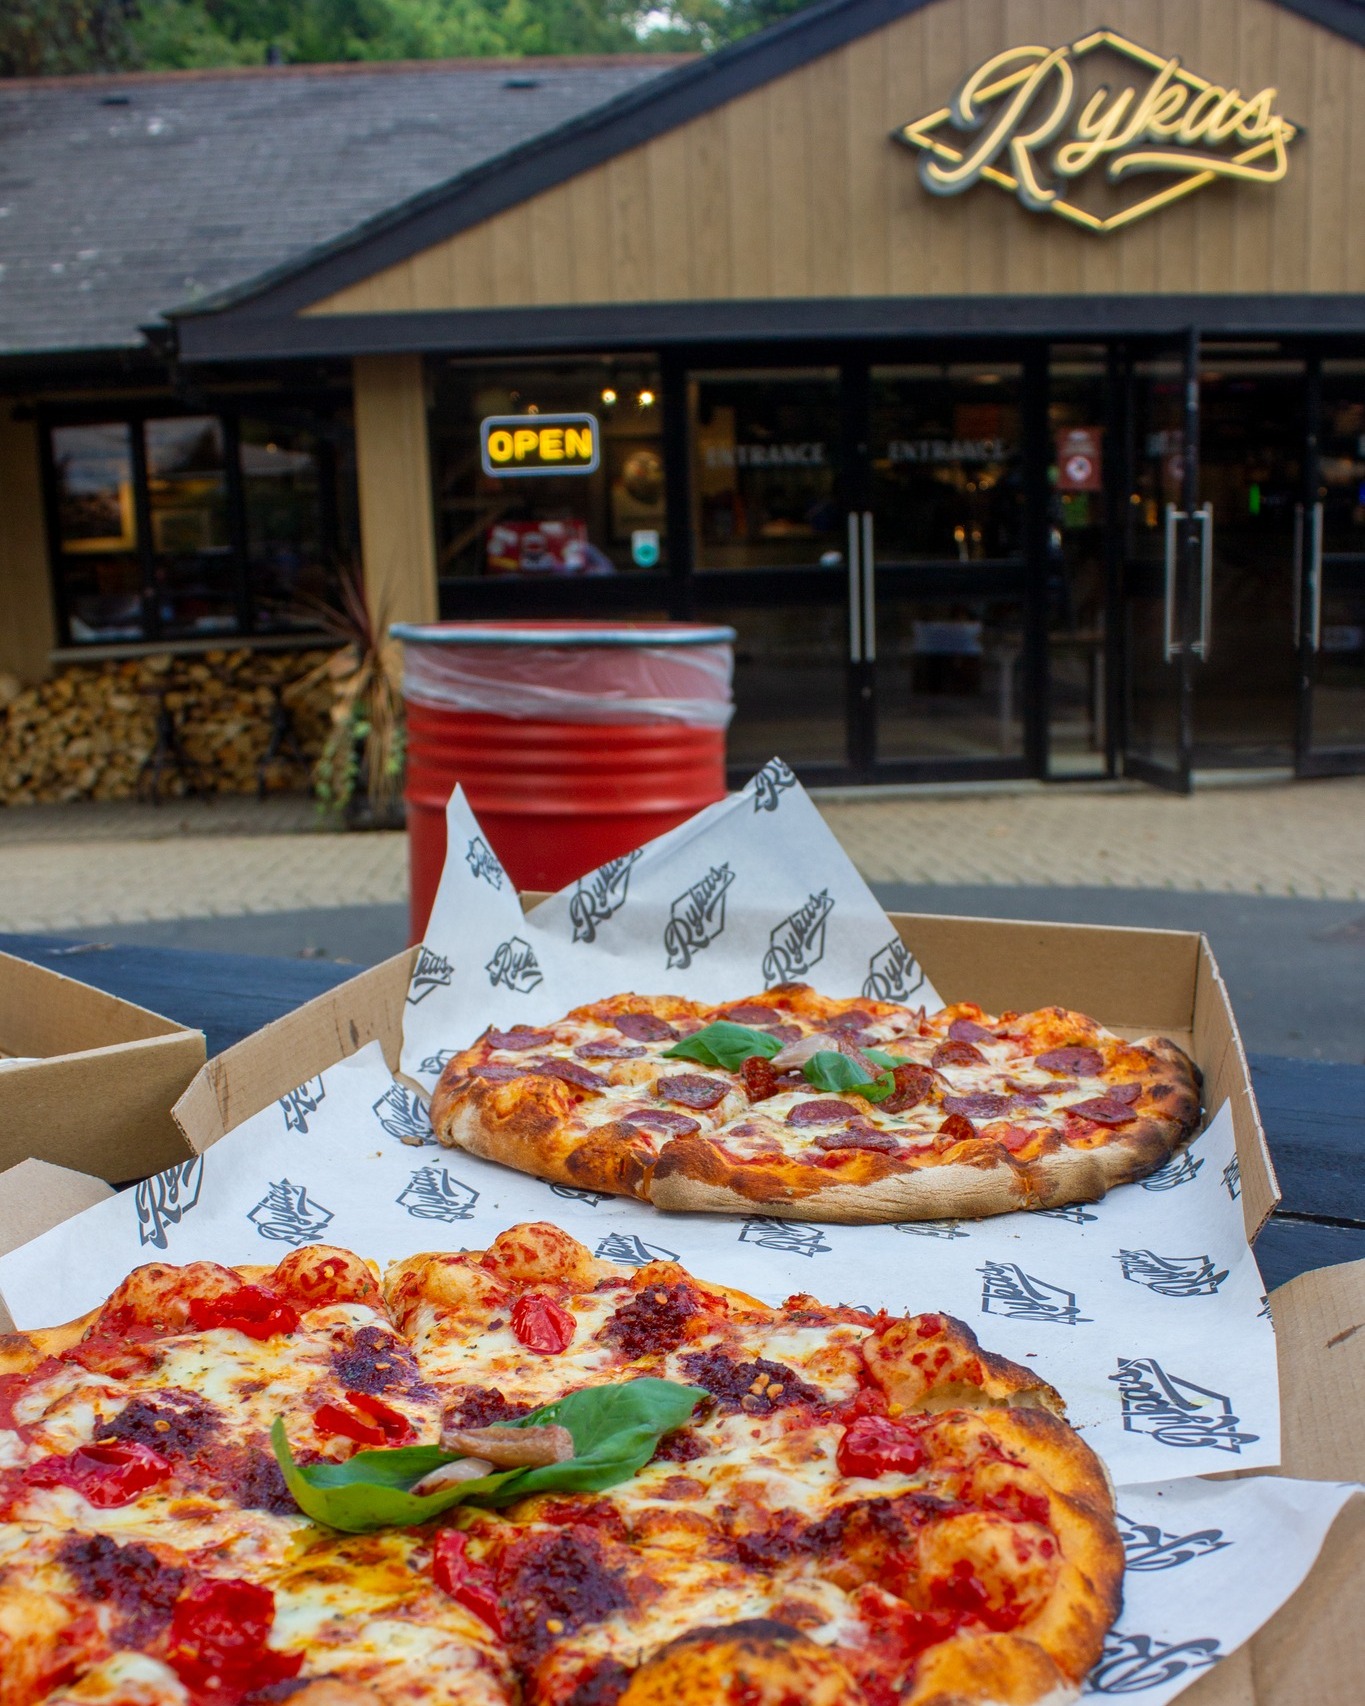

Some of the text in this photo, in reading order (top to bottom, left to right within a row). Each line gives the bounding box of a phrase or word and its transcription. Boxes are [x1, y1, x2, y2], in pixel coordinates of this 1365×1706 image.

[921, 45, 1288, 209] Rykas
[487, 428, 592, 462] OPEN
[705, 442, 826, 466] ENTRANCE
[890, 438, 1007, 462] ENTRANCE
[664, 866, 736, 970] Rykas
